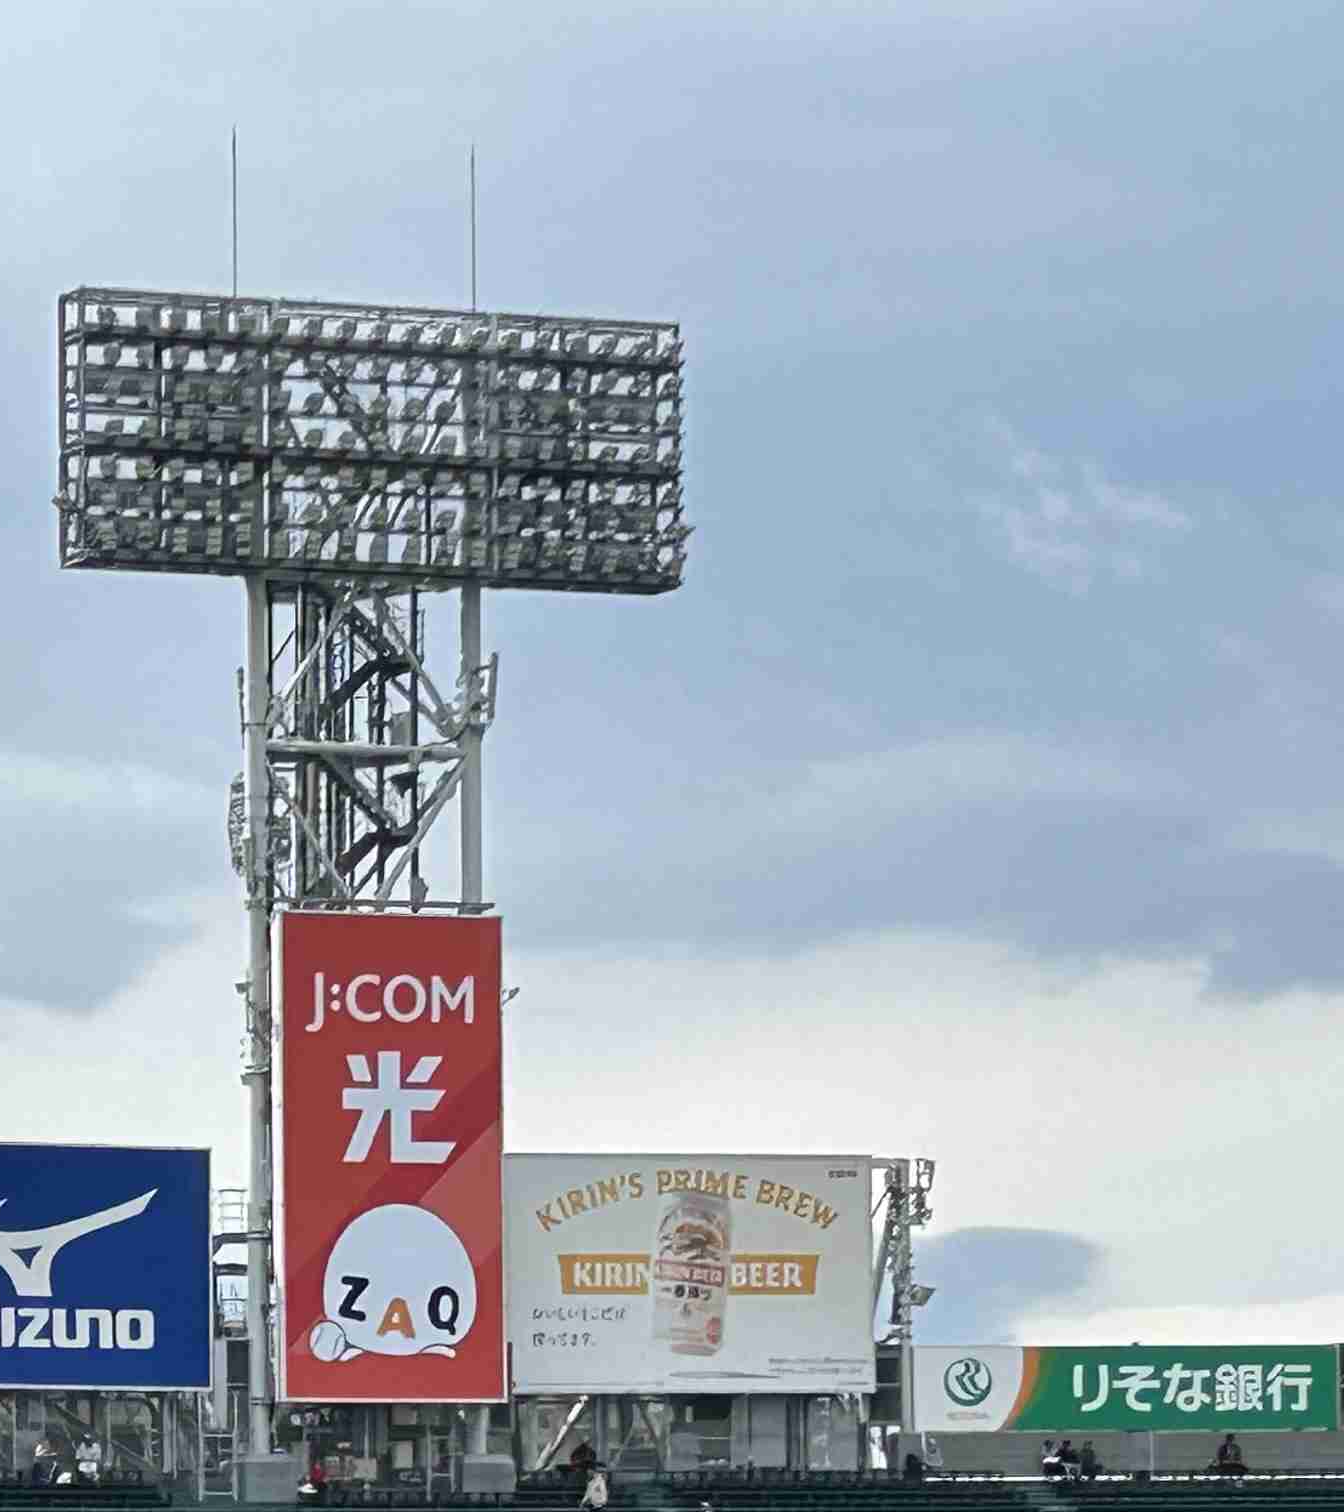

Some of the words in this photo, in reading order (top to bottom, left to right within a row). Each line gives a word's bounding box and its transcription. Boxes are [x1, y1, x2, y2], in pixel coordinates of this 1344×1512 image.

[305, 971, 475, 1032] J:COM
[342, 1051, 457, 1164] 光
[535, 1170, 644, 1233] KIRIN'S
[655, 1167, 749, 1200] PRIME
[755, 1178, 840, 1230] BREW
[572, 1261, 651, 1289] KIRIN
[731, 1261, 803, 1289] BEER
[338, 1275, 460, 1340] ZAQ
[1072, 1362, 1313, 1413] りそな銀行
